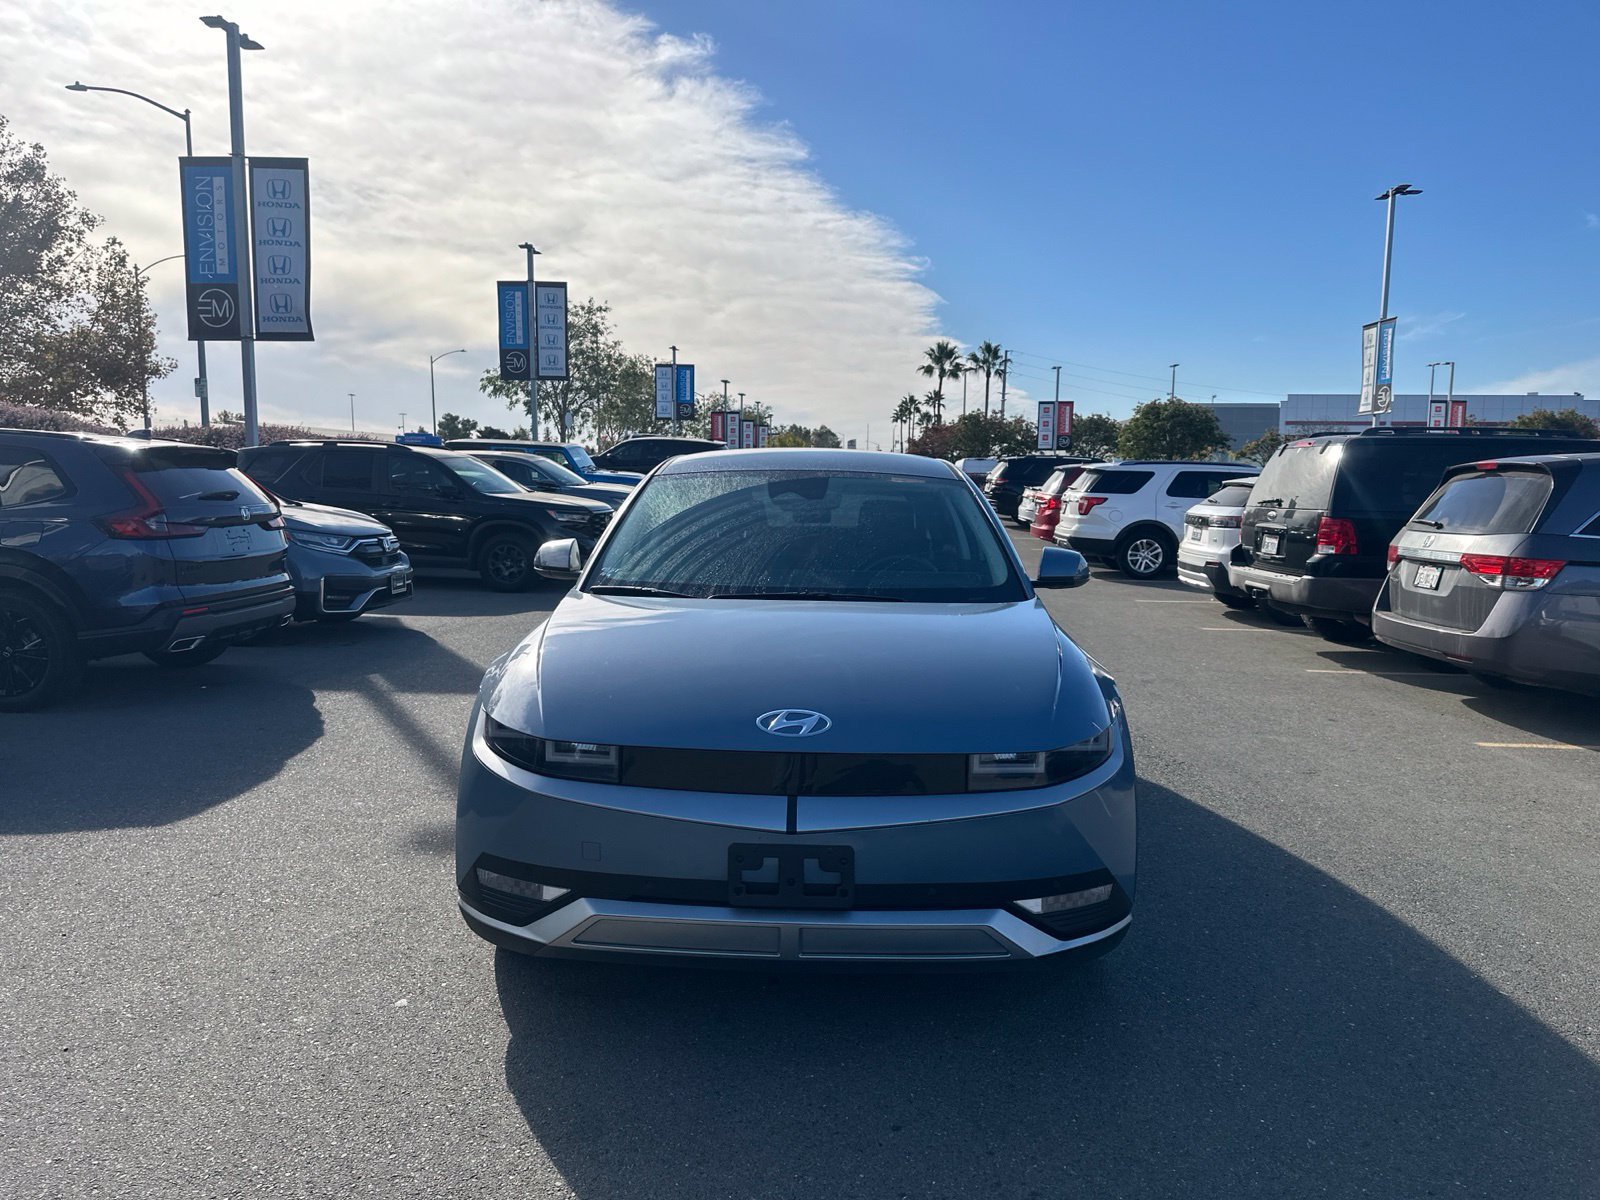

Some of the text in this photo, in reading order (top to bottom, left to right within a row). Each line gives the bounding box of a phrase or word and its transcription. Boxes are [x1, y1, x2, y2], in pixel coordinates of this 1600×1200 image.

[257, 201, 301, 209] HONDA
[195, 176, 215, 278] ENVISION
[215, 185, 227, 267] MOTORS
[258, 239, 302, 247] HONDA
[260, 277, 301, 285] HONDA
[262, 315, 303, 323] HONDA
[505, 290, 516, 345] ENVISION
